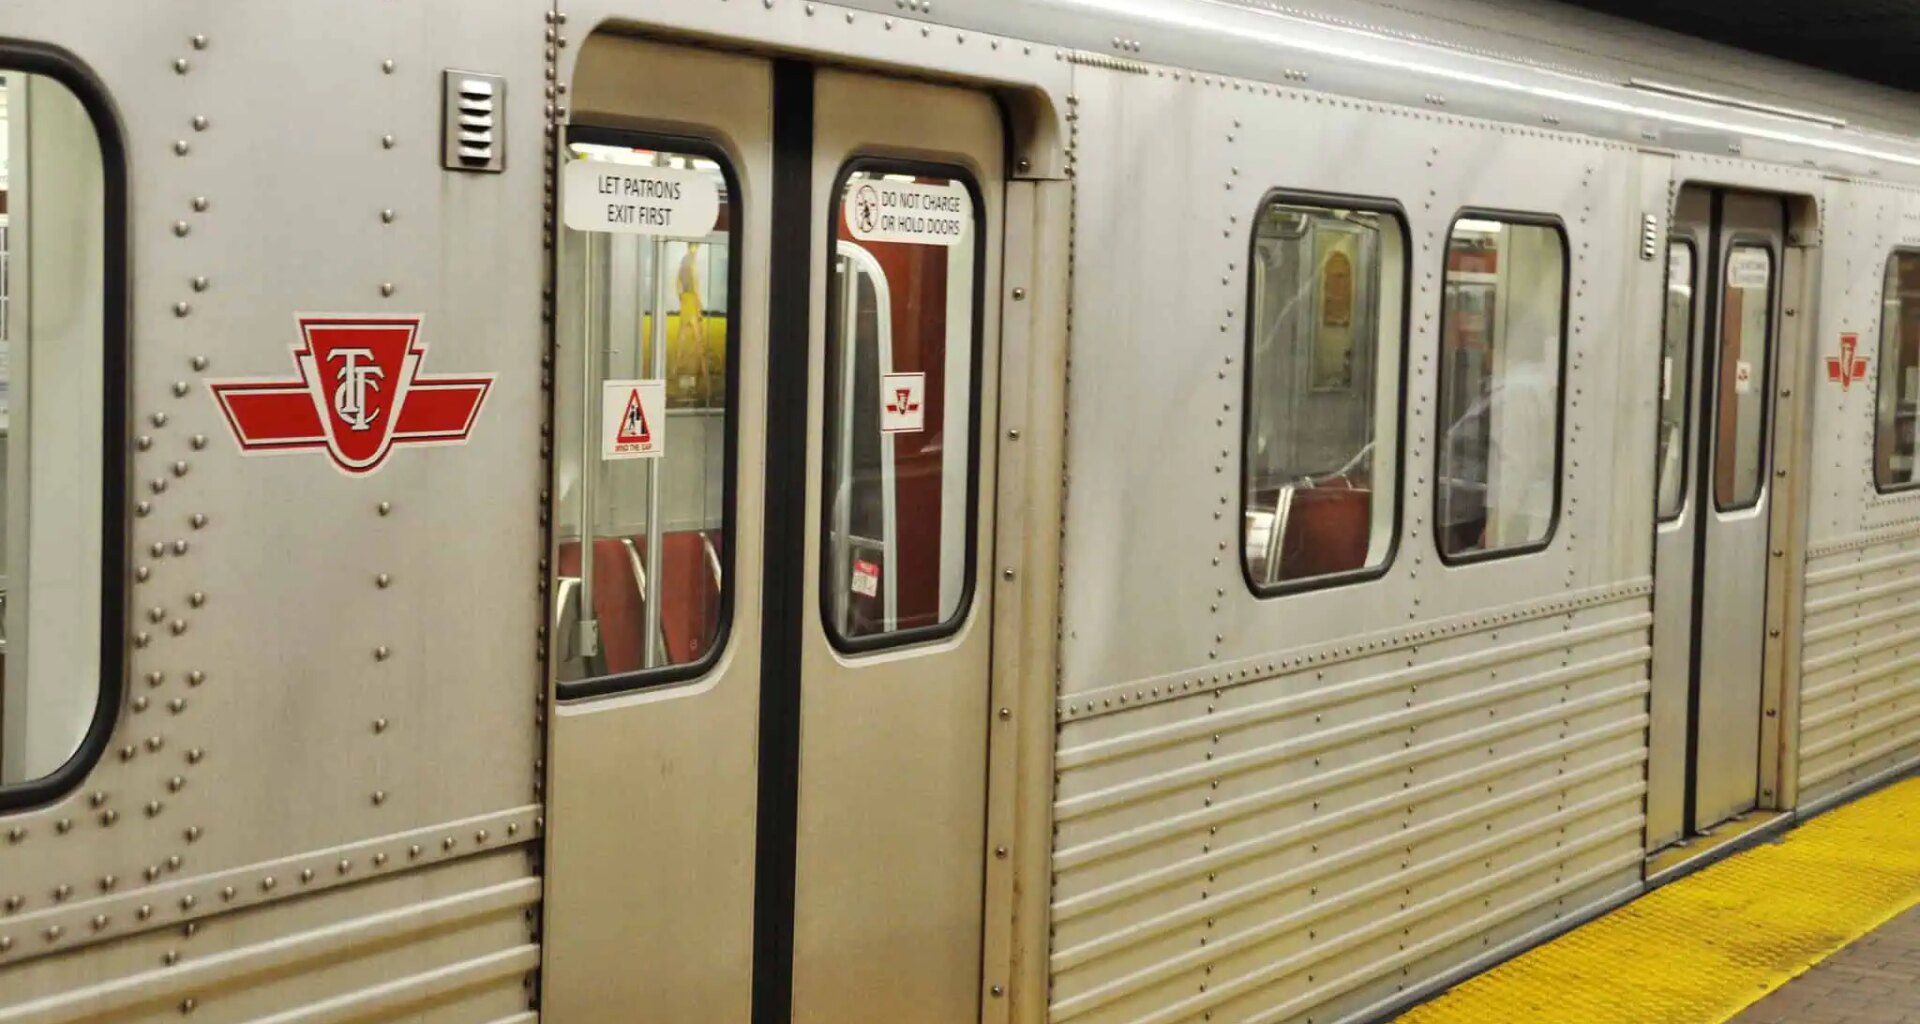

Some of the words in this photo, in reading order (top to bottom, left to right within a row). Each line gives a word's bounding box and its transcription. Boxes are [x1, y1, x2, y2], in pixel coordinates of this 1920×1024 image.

[599, 176, 620, 195] LET
[624, 178, 681, 200] PATRONS
[881, 191, 897, 208] DO
[900, 193, 920, 209] NOT
[923, 194, 961, 213] CHARGE
[608, 204, 635, 224] EXIT
[639, 206, 672, 226] FIRST
[881, 215, 895, 232] OR
[898, 216, 924, 233] HOLD
[927, 218, 960, 236] DOORS
